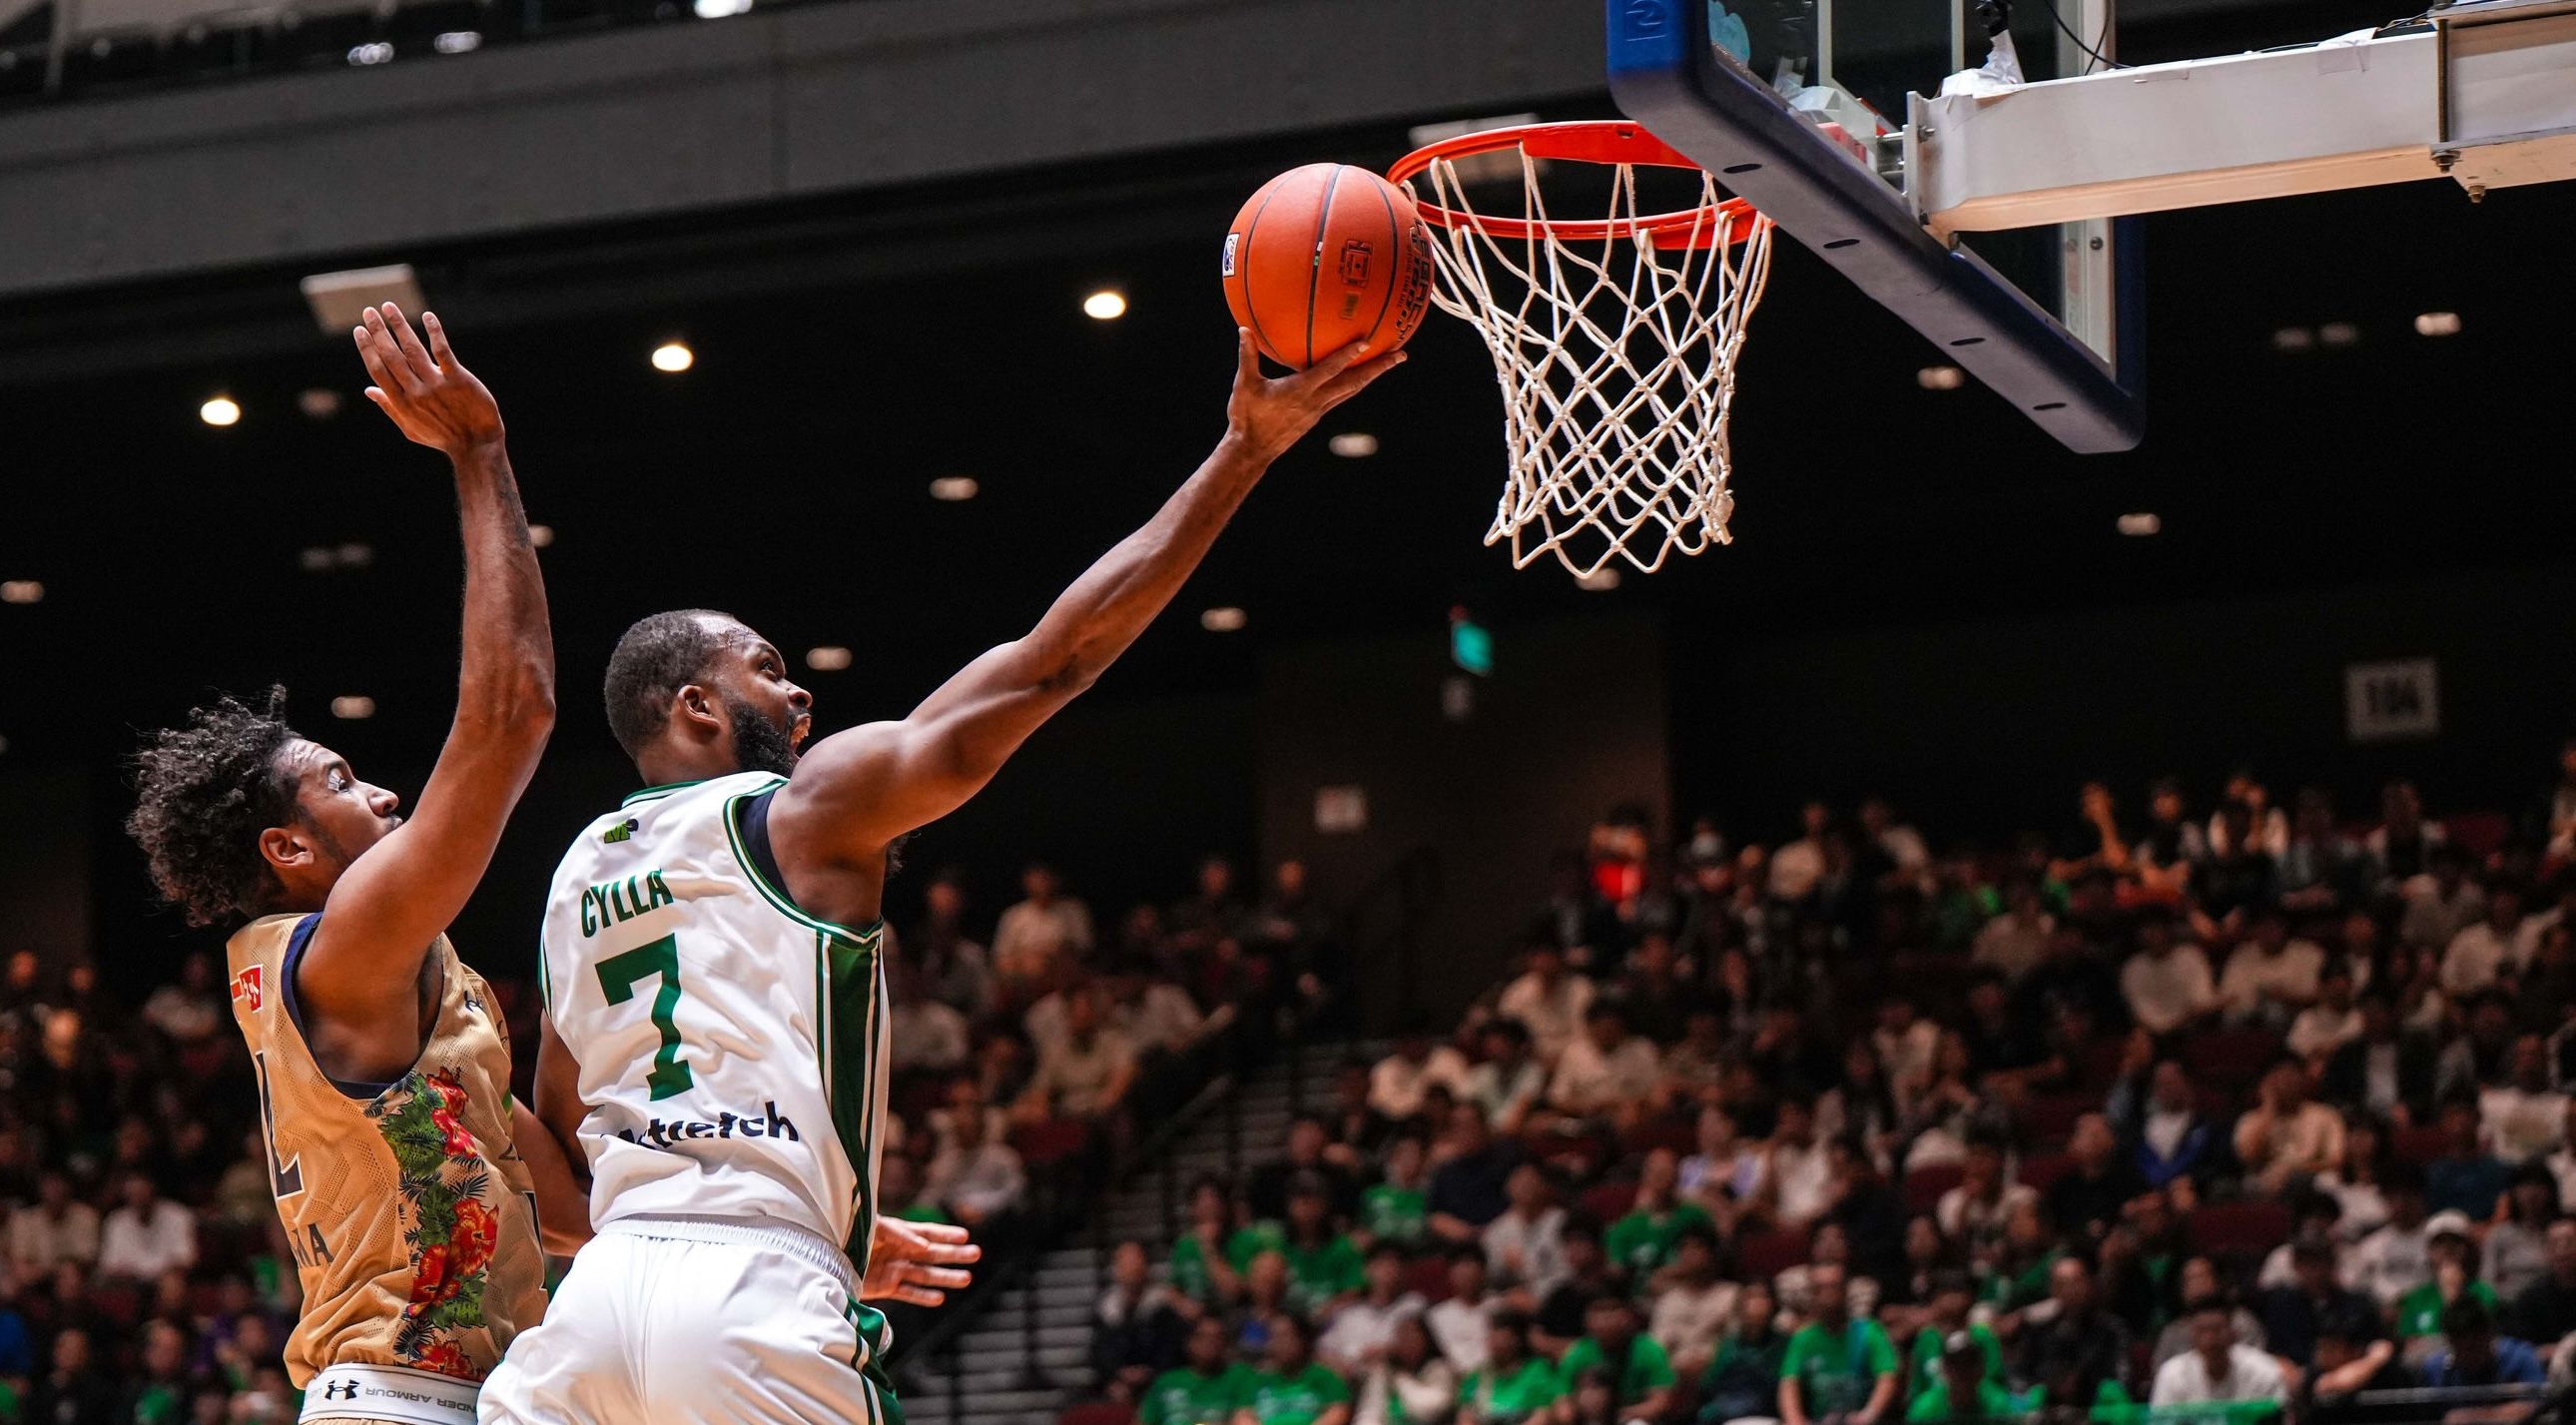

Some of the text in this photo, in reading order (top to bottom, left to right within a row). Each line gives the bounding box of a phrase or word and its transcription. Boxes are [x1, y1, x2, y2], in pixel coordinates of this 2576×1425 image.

[580, 869, 674, 938] CYLLA
[594, 932, 695, 1102] 7
[365, 1388, 477, 1413] NDER ARMOUR
